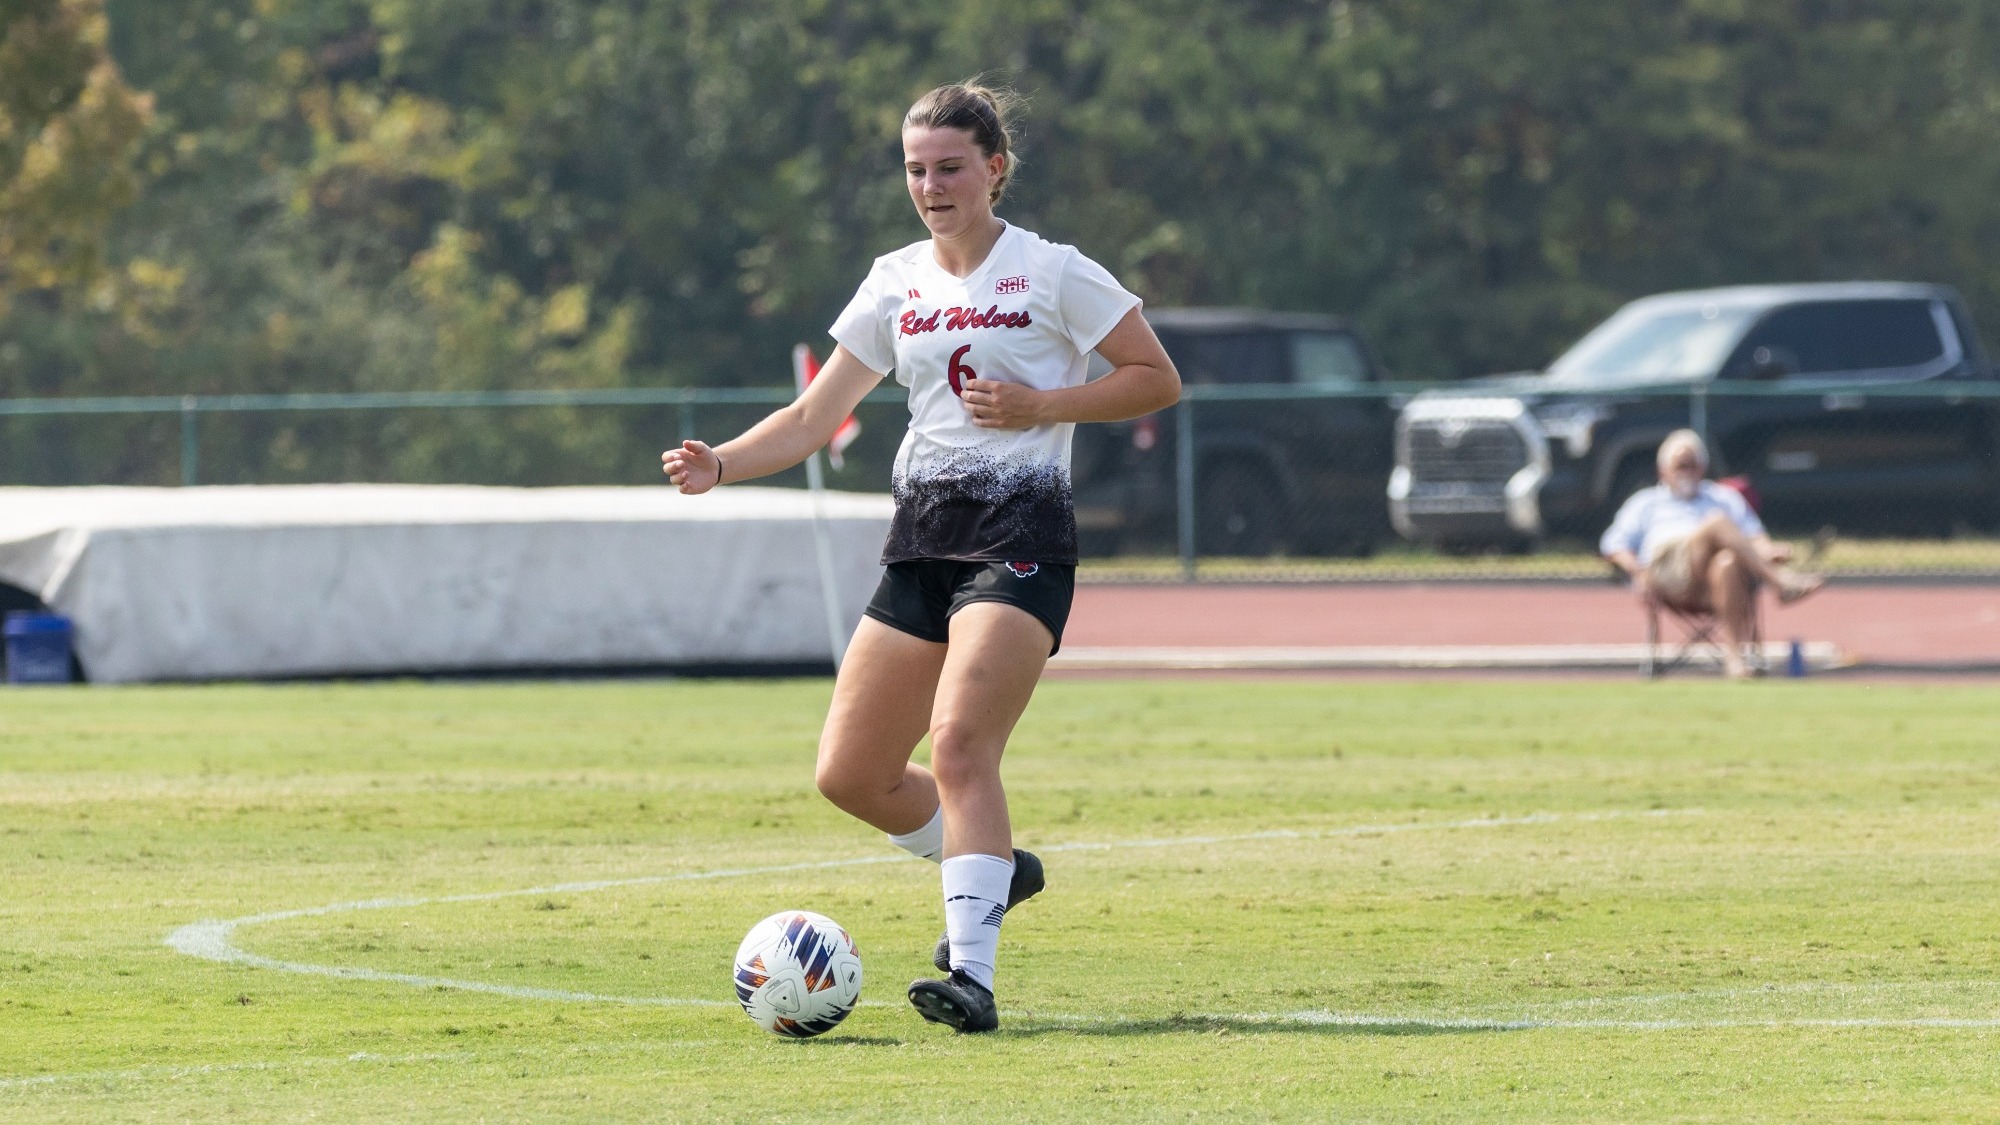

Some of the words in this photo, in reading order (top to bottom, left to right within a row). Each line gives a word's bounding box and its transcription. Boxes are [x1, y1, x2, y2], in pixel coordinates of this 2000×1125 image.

[995, 275, 1030, 294] SBC
[899, 308, 941, 339] Red
[944, 304, 1032, 331] Wolves
[947, 344, 977, 400] 6
